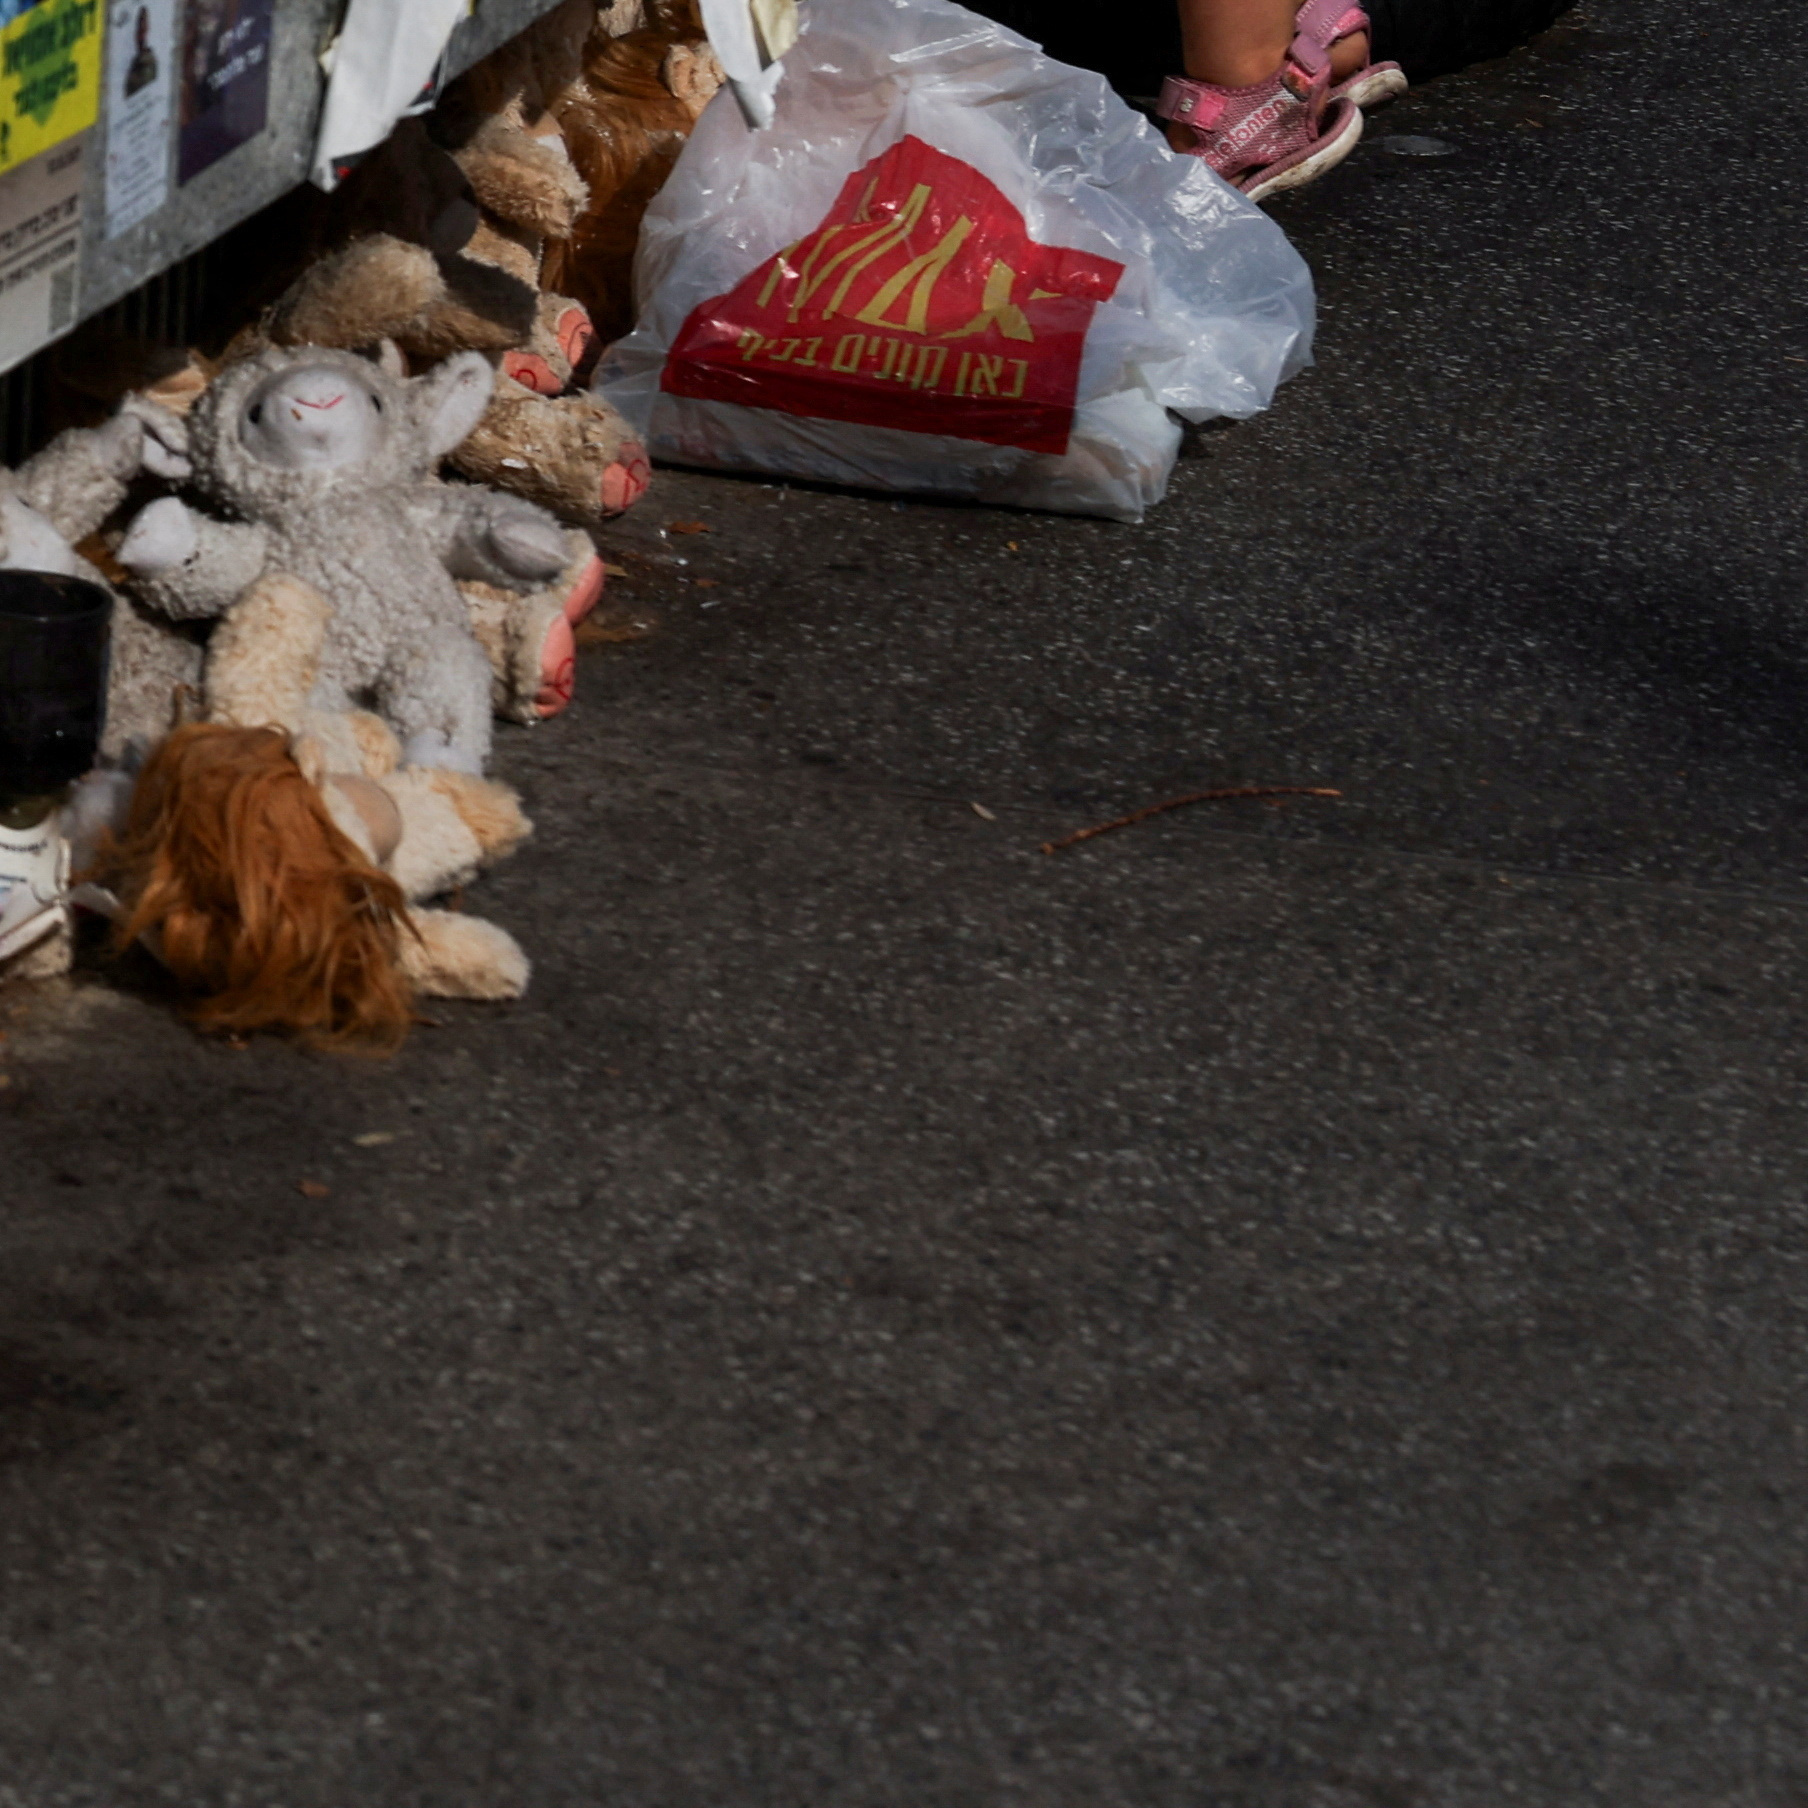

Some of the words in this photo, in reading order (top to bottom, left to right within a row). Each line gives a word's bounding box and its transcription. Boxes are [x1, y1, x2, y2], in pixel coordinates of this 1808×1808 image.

[736, 325, 824, 367] בכיף
[832, 333, 949, 392] קונים
[952, 350, 1029, 399] כאן
